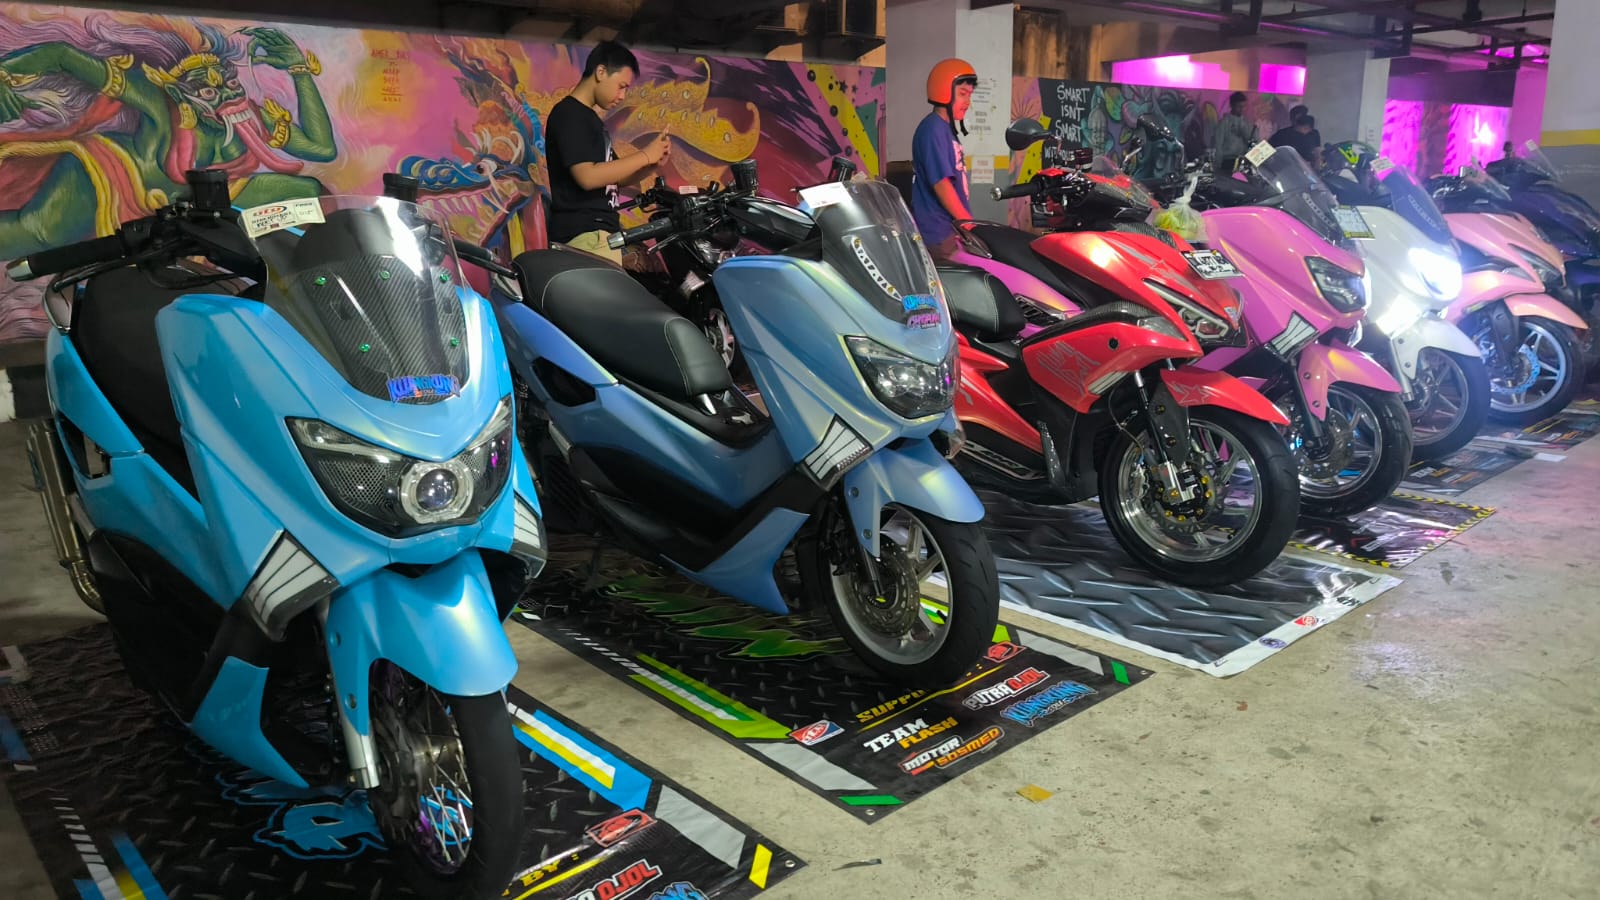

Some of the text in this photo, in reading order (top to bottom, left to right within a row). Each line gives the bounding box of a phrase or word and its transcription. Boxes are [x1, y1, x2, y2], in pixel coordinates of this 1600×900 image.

[1057, 83, 1090, 103] SMART
[1056, 120, 1081, 142] SMART
[965, 683, 1013, 708] PUTRA
[863, 718, 930, 752] TEAM
[899, 716, 959, 749] FLASH
[936, 727, 1000, 766] SOSMED
[903, 736, 961, 771] MOTOR
